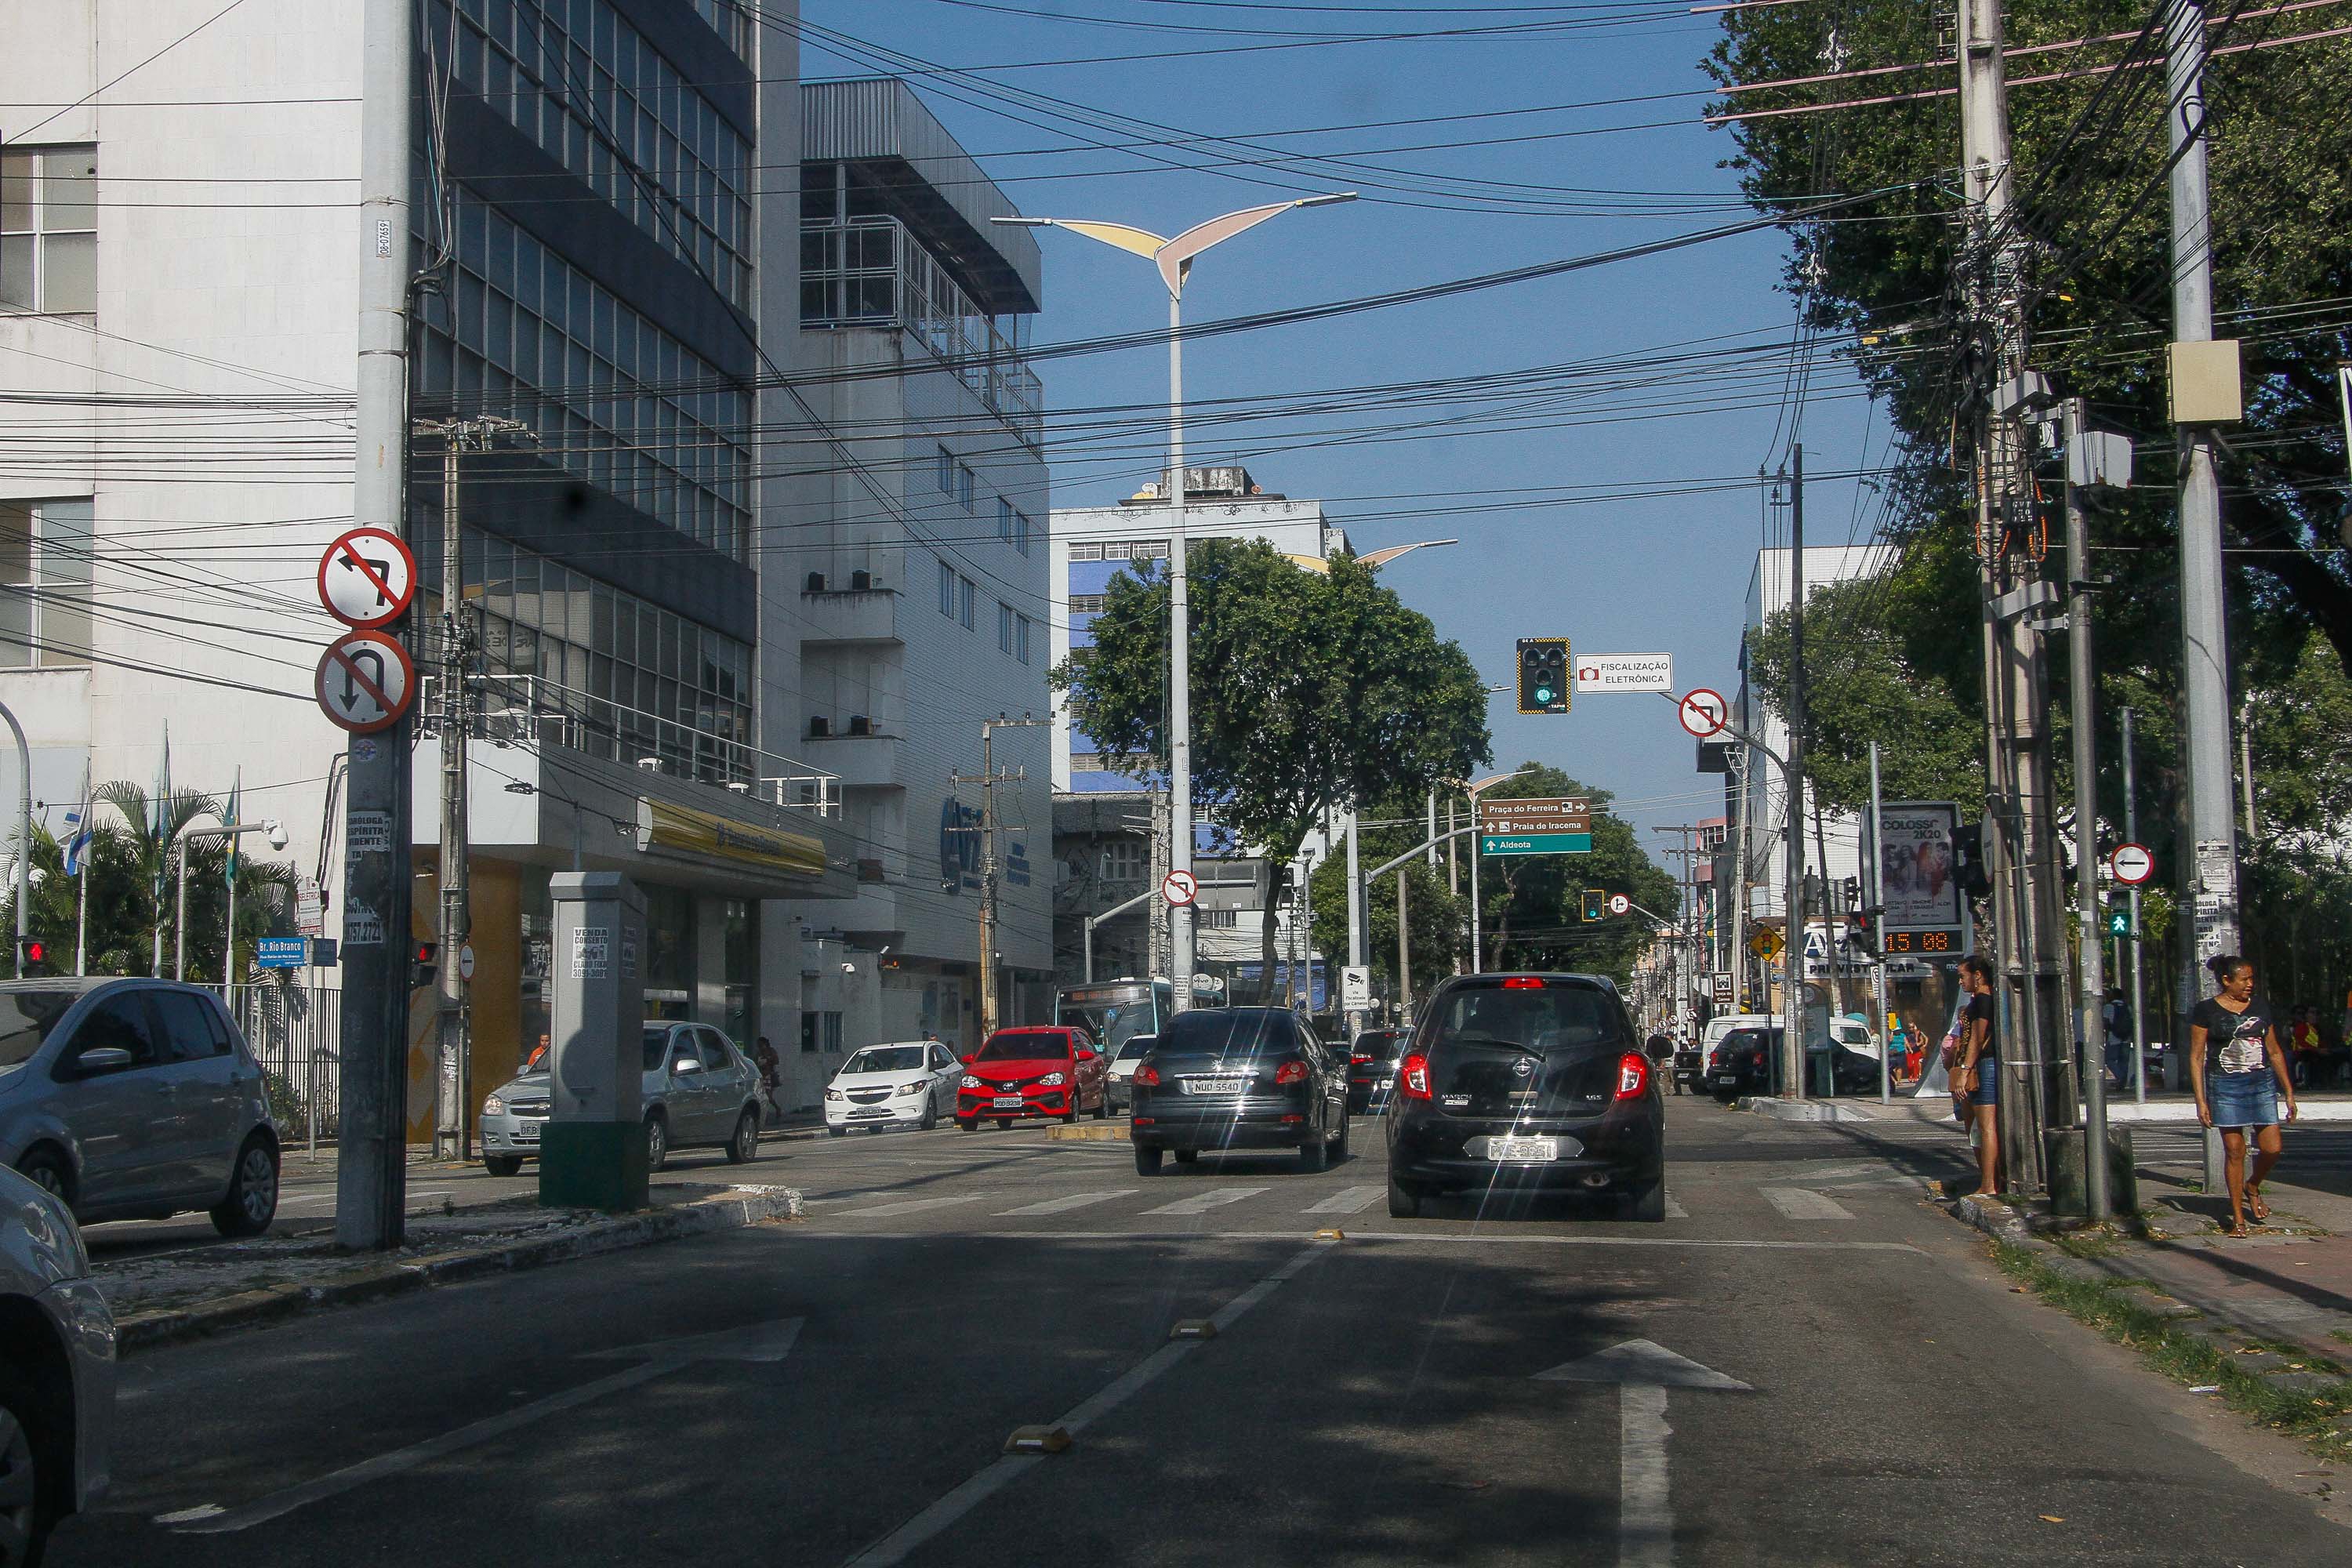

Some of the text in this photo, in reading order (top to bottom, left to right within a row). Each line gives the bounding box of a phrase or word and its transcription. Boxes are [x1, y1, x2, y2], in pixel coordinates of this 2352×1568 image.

[379, 223, 389, 254] 08-07659
[1601, 662, 1668, 671] FISCALIZAÇÃO
[1606, 675, 1664, 684] ELETRÔNICA
[260, 942, 301, 952] Br. Rio Branco
[1885, 933, 1948, 951] 15 08
